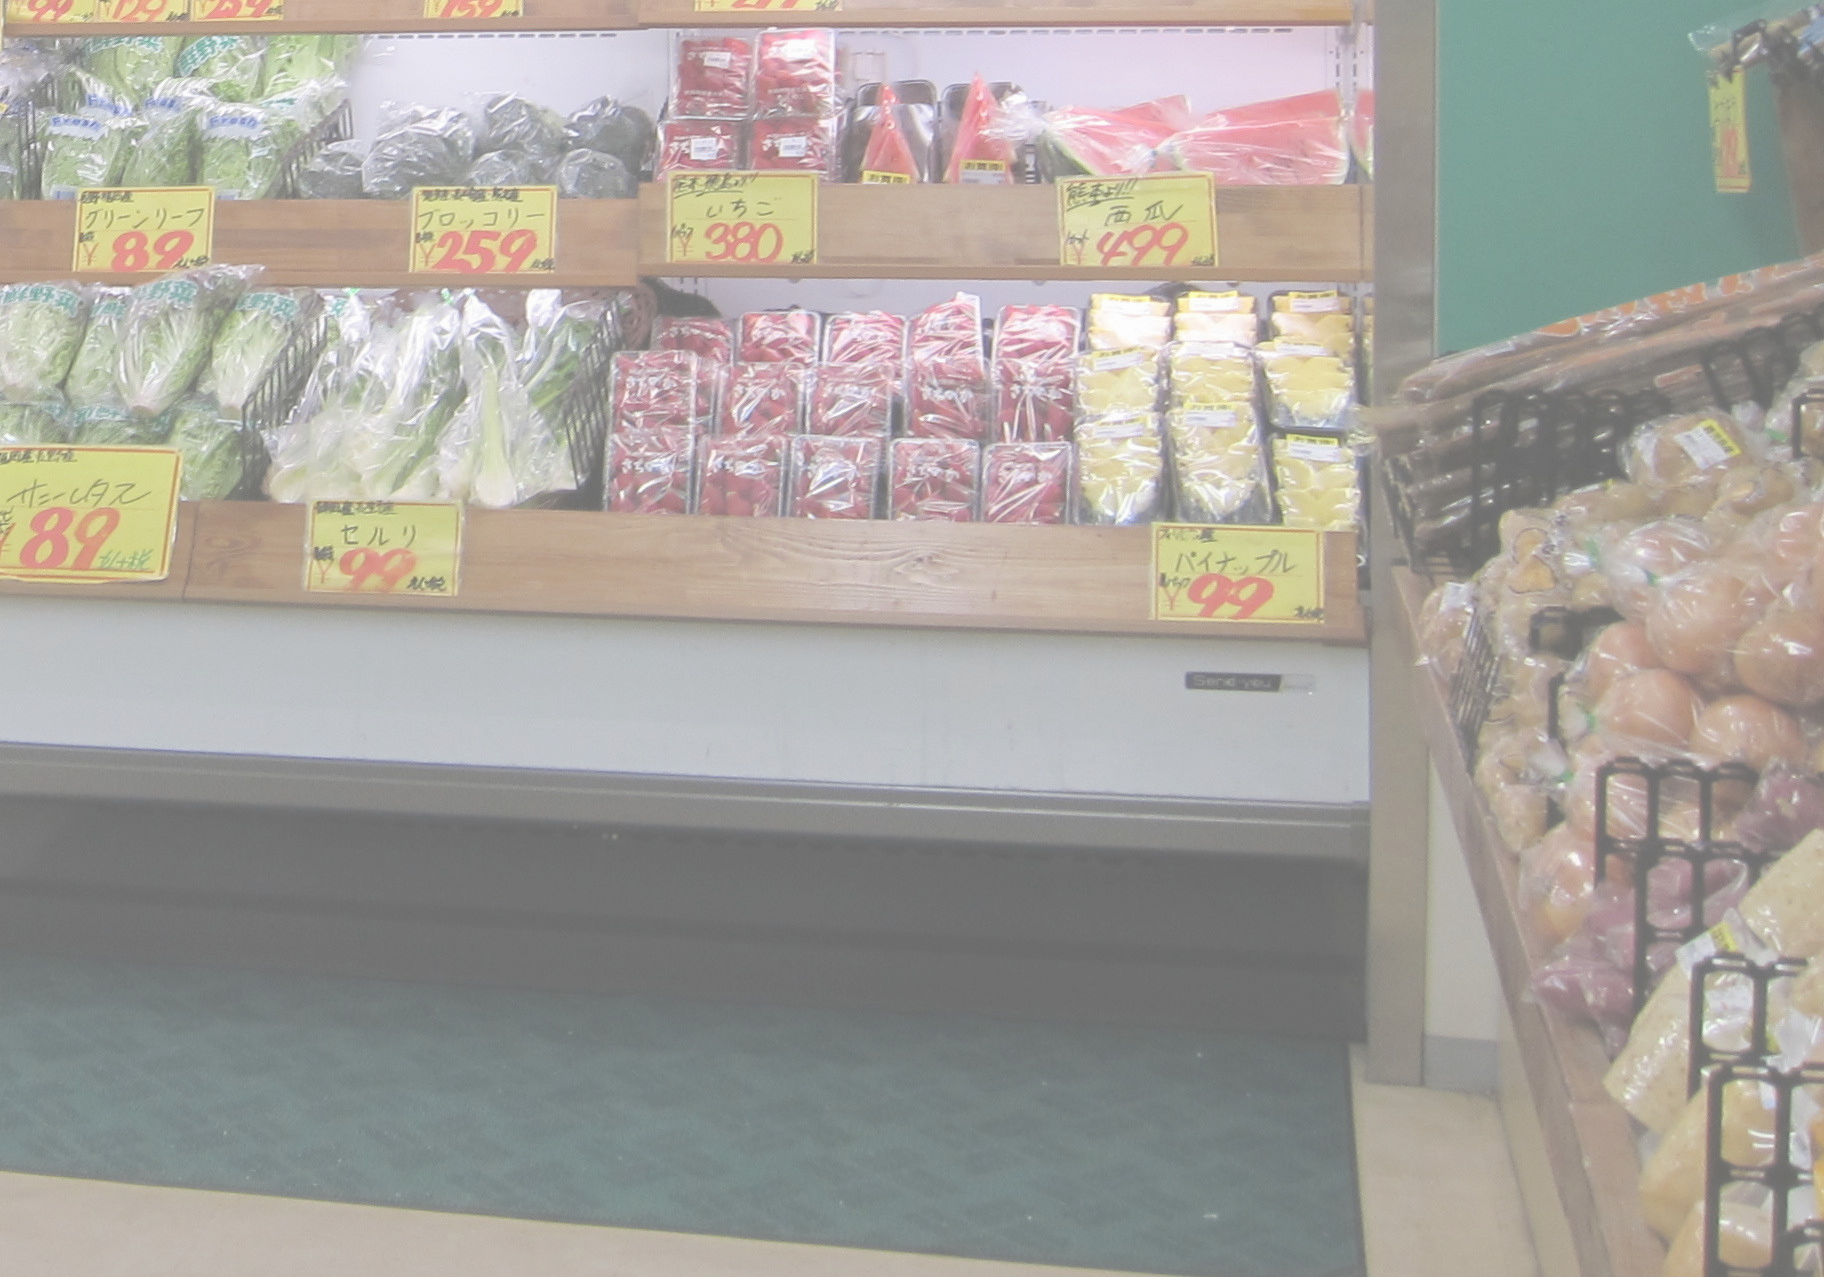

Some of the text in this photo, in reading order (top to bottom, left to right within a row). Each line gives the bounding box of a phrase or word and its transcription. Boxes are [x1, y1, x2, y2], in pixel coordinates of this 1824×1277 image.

[84, 207, 206, 230] グリーンリーフ
[417, 209, 546, 231] ブロッコリー
[706, 196, 783, 220] いちご
[1104, 200, 1184, 227] 西瓜
[111, 230, 195, 273] 89
[429, 229, 539, 274] 259
[704, 221, 785, 264] 380
[1096, 222, 1189, 267] 499
[7, 478, 152, 509] サニーレタス
[19, 507, 121, 571] 89
[339, 524, 417, 549] セルリ
[338, 547, 418, 593] 99
[1175, 549, 1298, 575] パイナップル
[1187, 574, 1275, 620] 99
